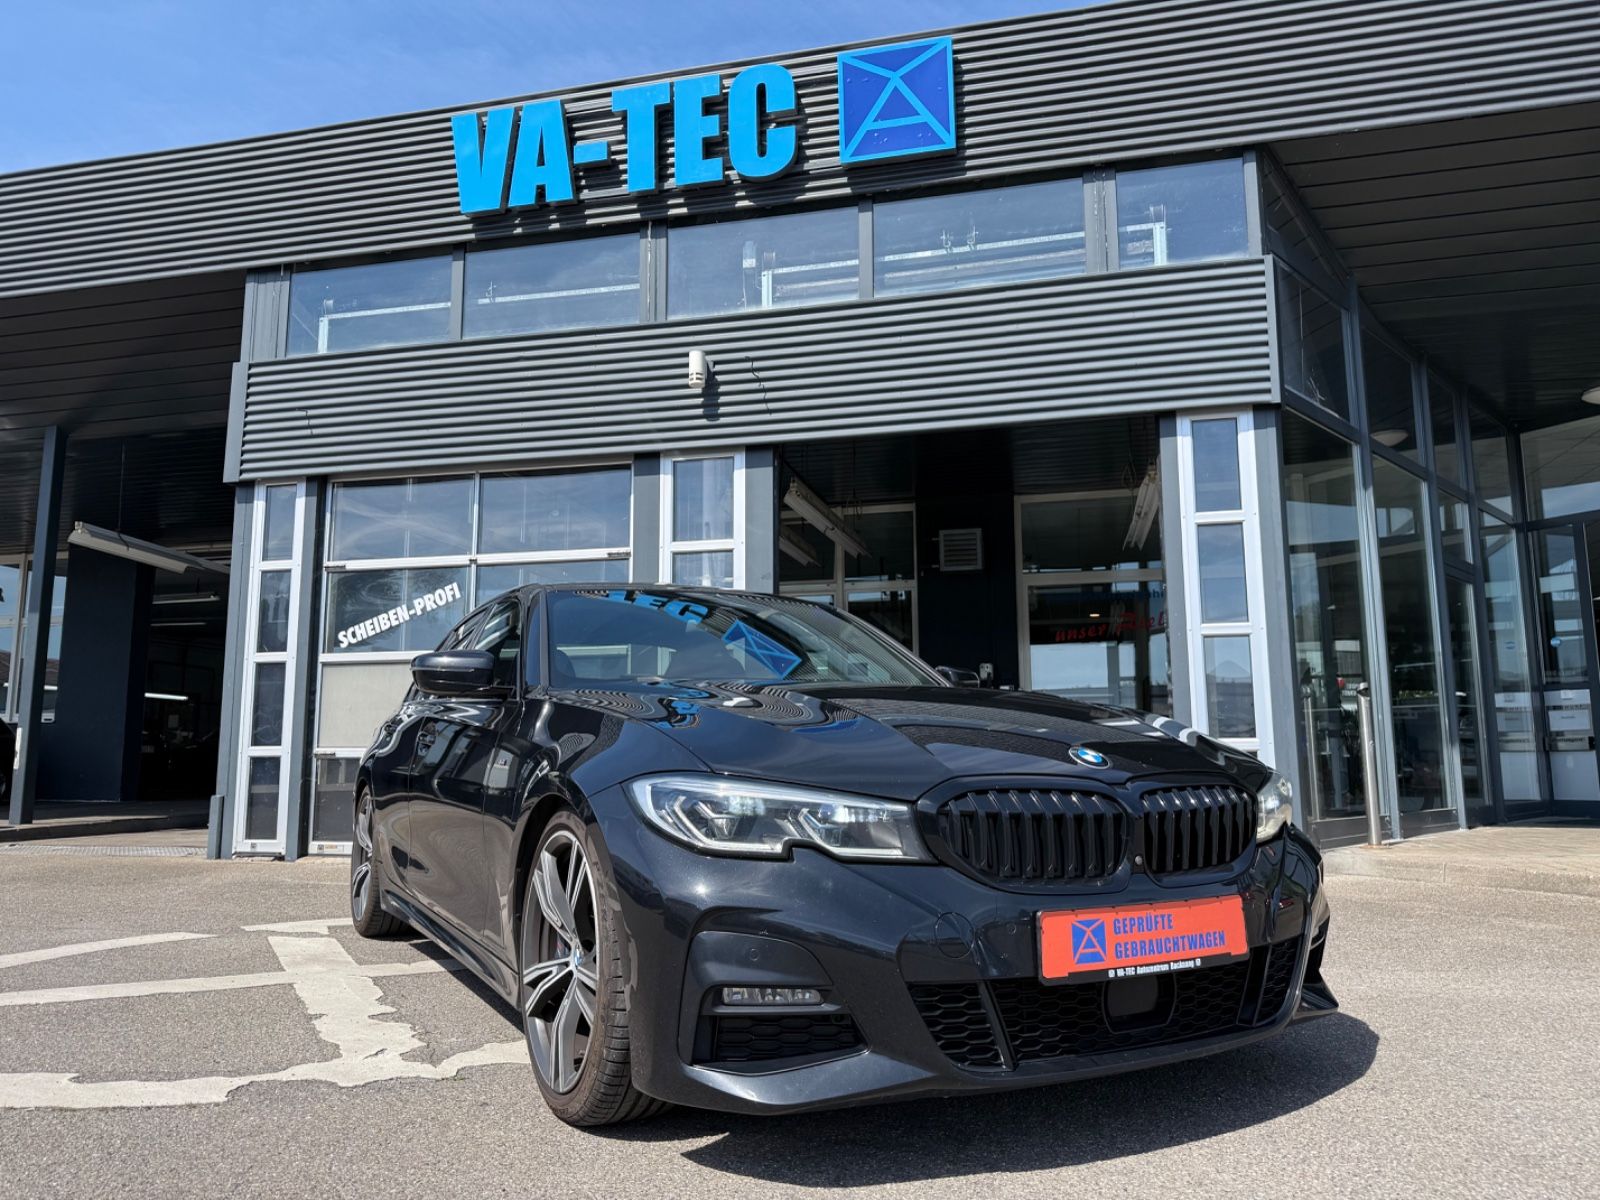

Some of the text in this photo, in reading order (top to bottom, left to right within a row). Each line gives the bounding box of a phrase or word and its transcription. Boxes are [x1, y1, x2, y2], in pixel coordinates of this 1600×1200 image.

[451, 64, 798, 214] VA-TEC
[337, 582, 461, 648] SCHEIBEN-PROFI
[1113, 912, 1173, 935] GEPRÜFTE
[1114, 931, 1226, 960] GEBRAUCHTWAGEN
